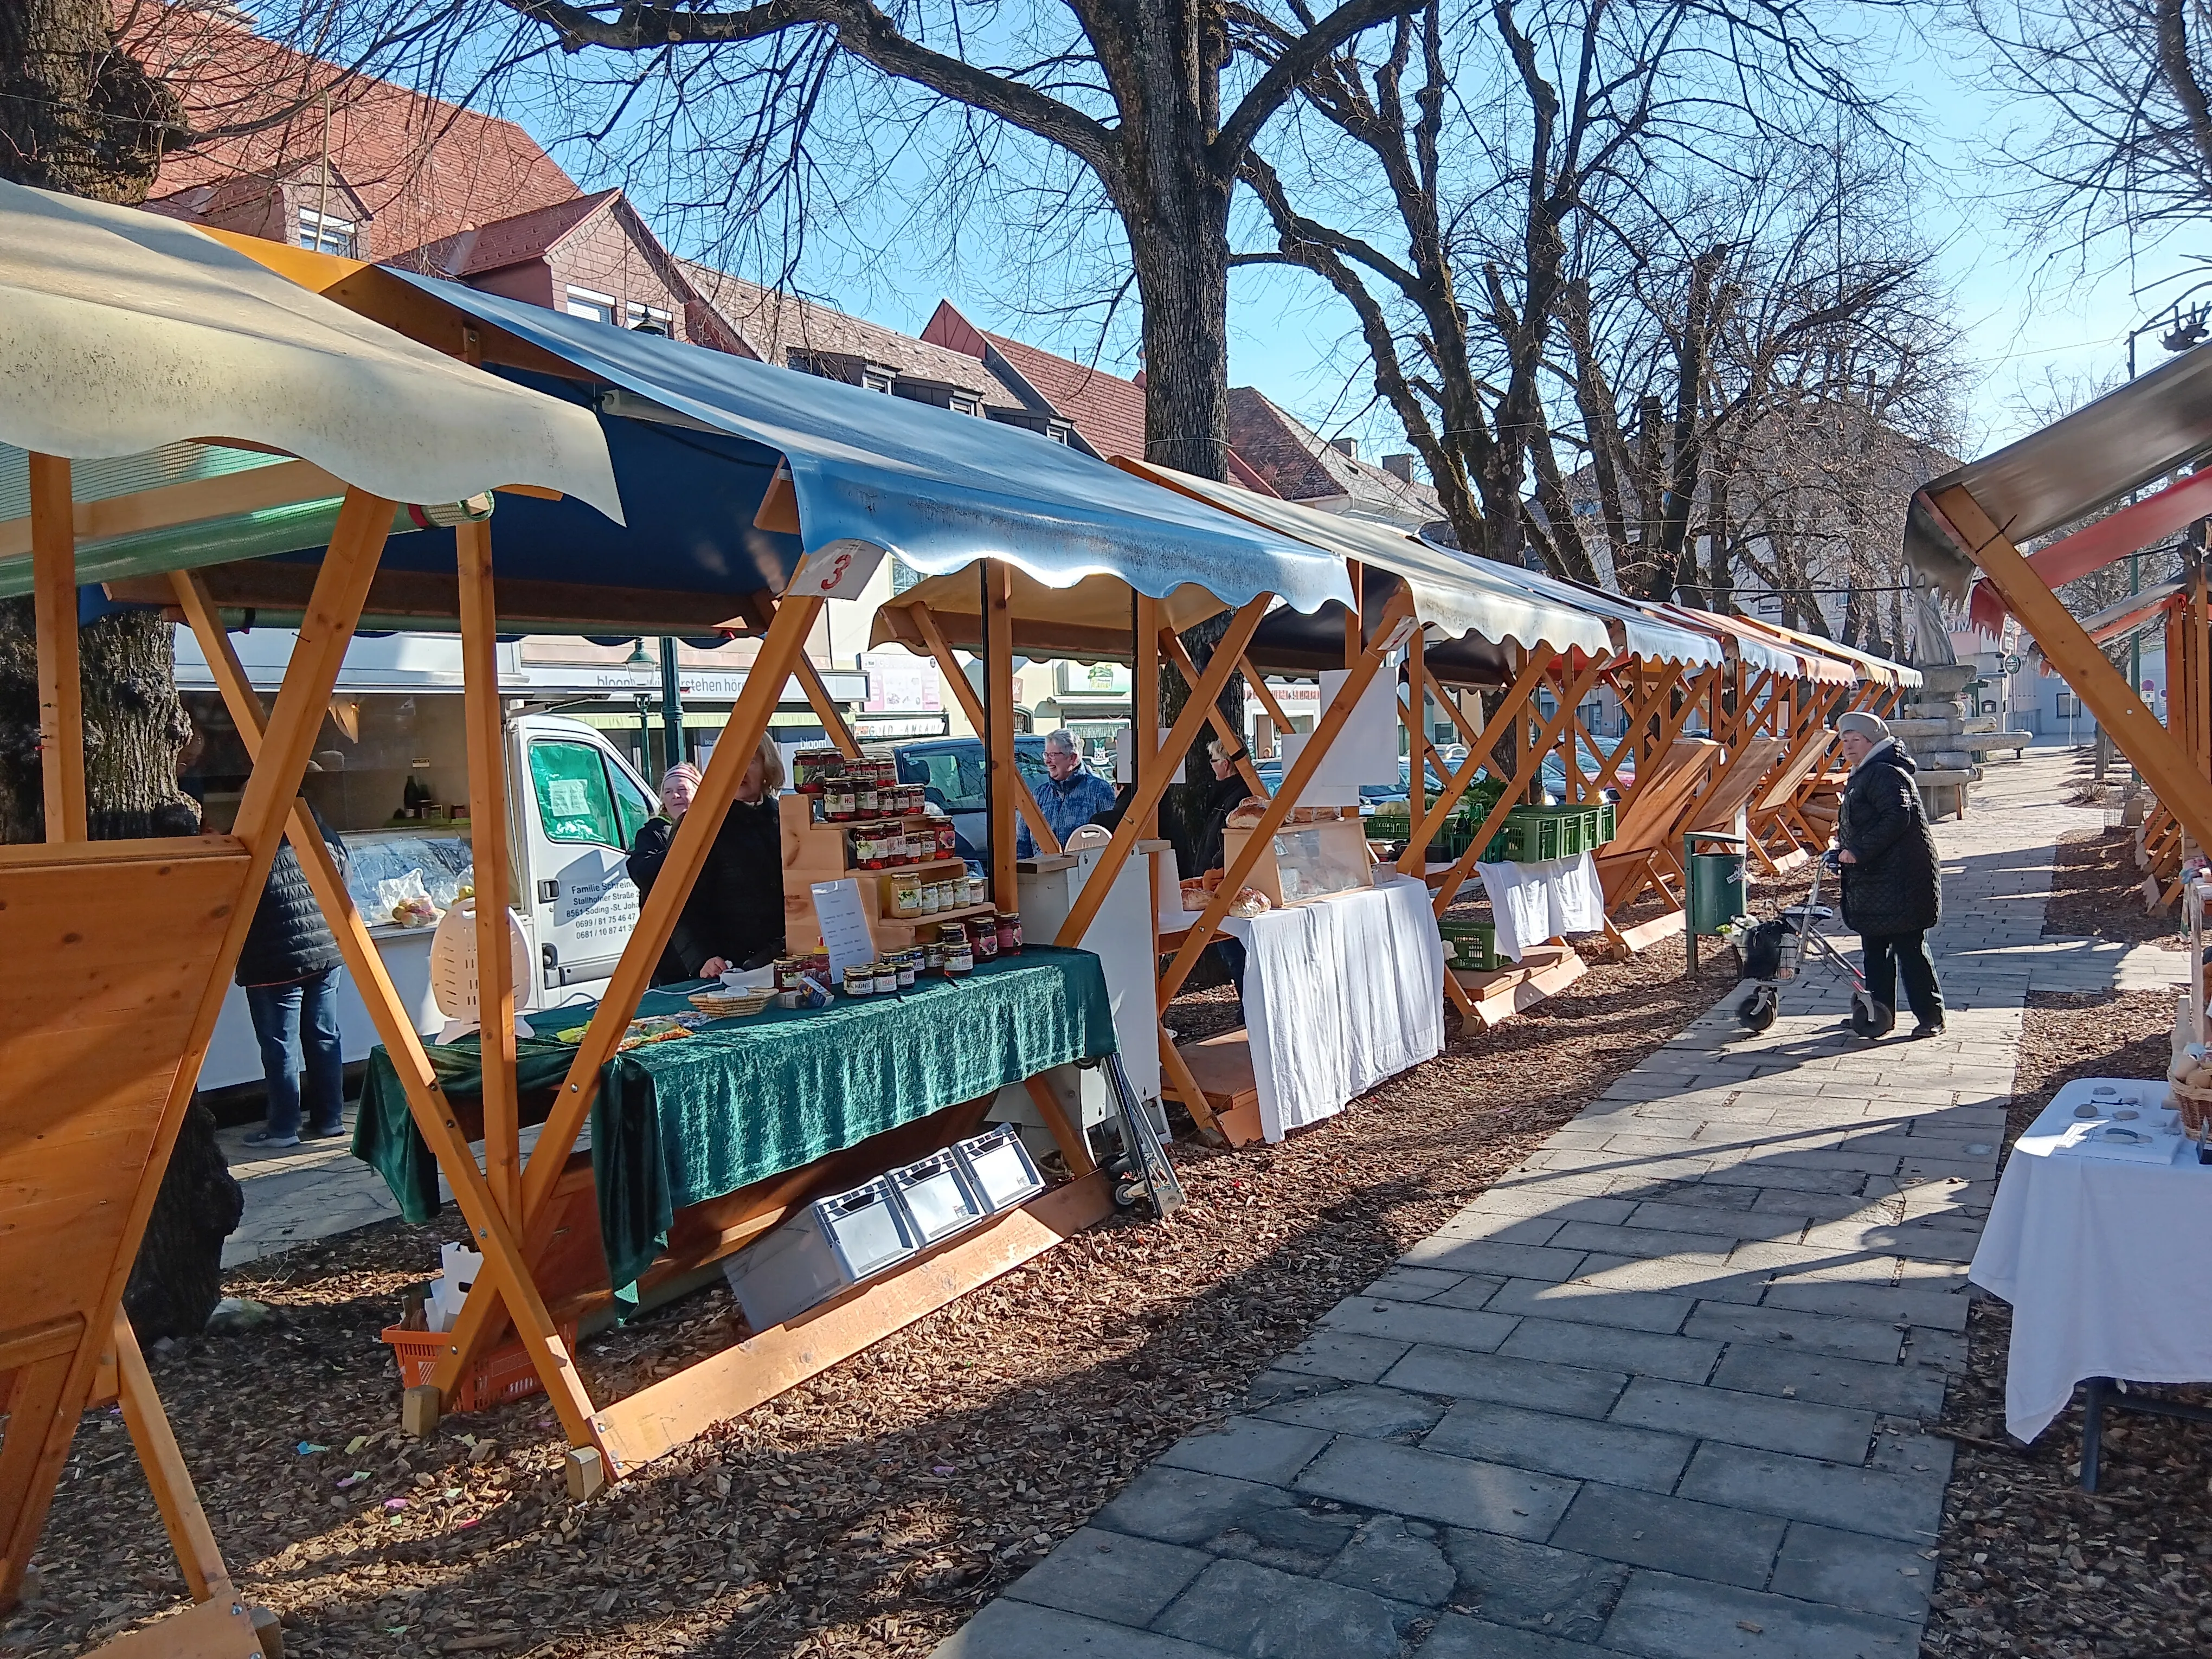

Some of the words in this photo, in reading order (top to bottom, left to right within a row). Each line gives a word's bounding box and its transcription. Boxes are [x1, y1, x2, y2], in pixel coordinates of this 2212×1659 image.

[821, 554, 852, 590] 3
[800, 737, 827, 749] bloom
[571, 883, 600, 895] Familie
[613, 891, 635, 901] Straße
[567, 909, 583, 918] 8561
[576, 919, 593, 929] 0699
[599, 917, 606, 925] 81
[608, 916, 617, 924] 75
[627, 913, 636, 921] 47
[576, 930, 593, 940] 0681
[599, 928, 607, 936] 10
[608, 927, 617, 935] 87
[855, 981, 871, 989] HONIG
